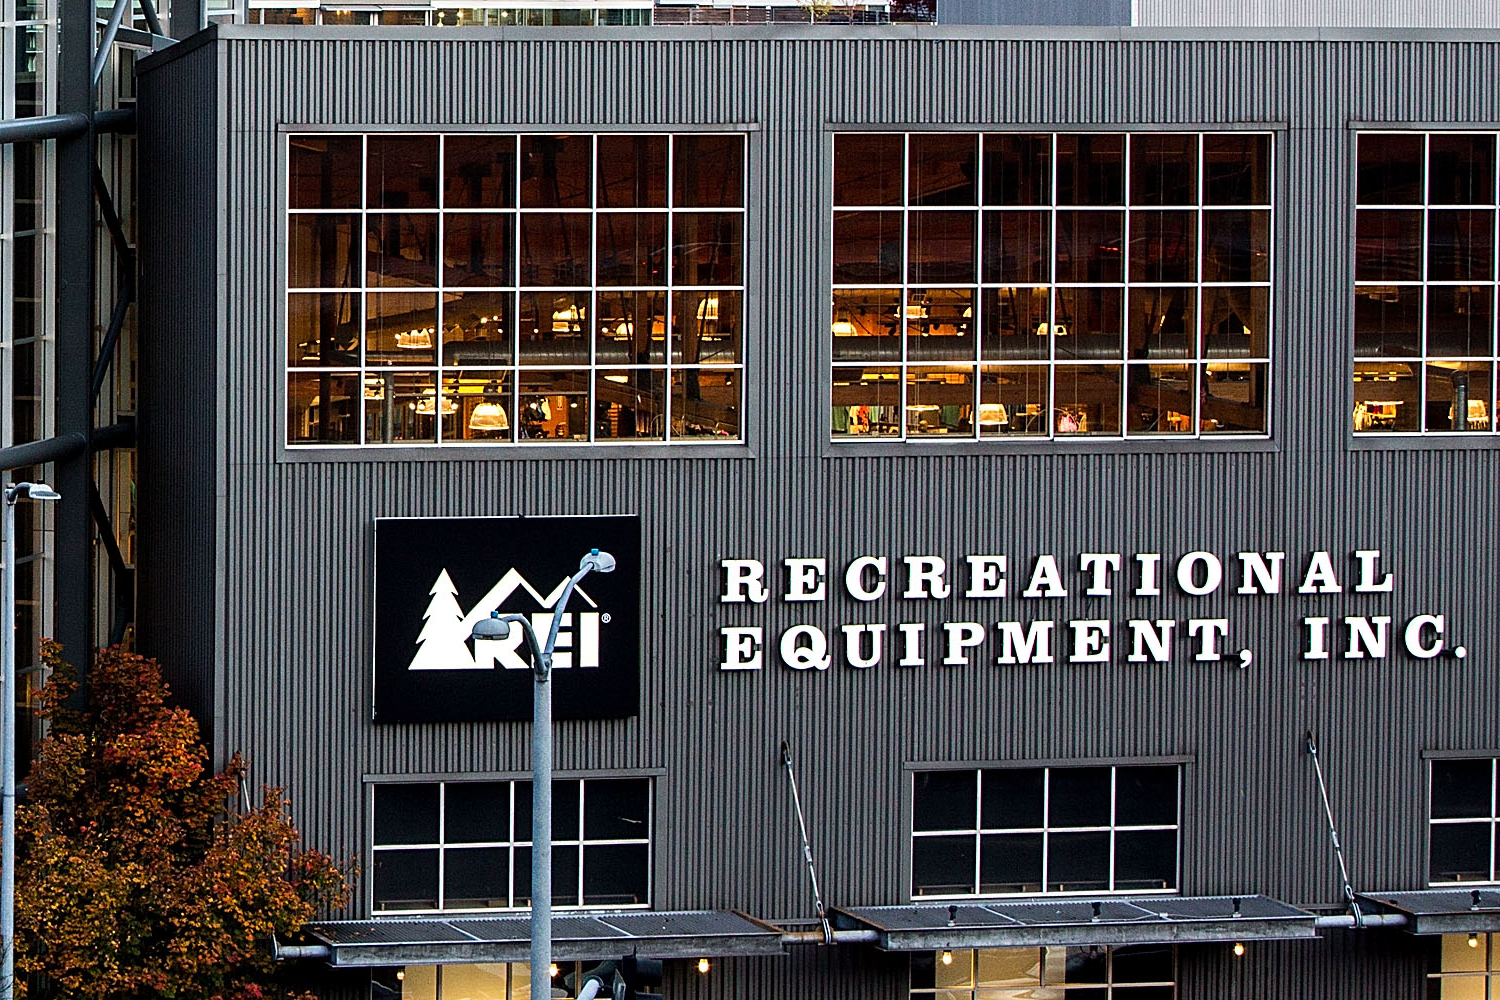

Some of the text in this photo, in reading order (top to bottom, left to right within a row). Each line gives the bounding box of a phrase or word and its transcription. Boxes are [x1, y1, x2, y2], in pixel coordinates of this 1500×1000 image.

[720, 550, 1395, 604] RECREATIONAL
[474, 612, 599, 669] REI
[720, 613, 1468, 671] EQUIPMENT, INC.
